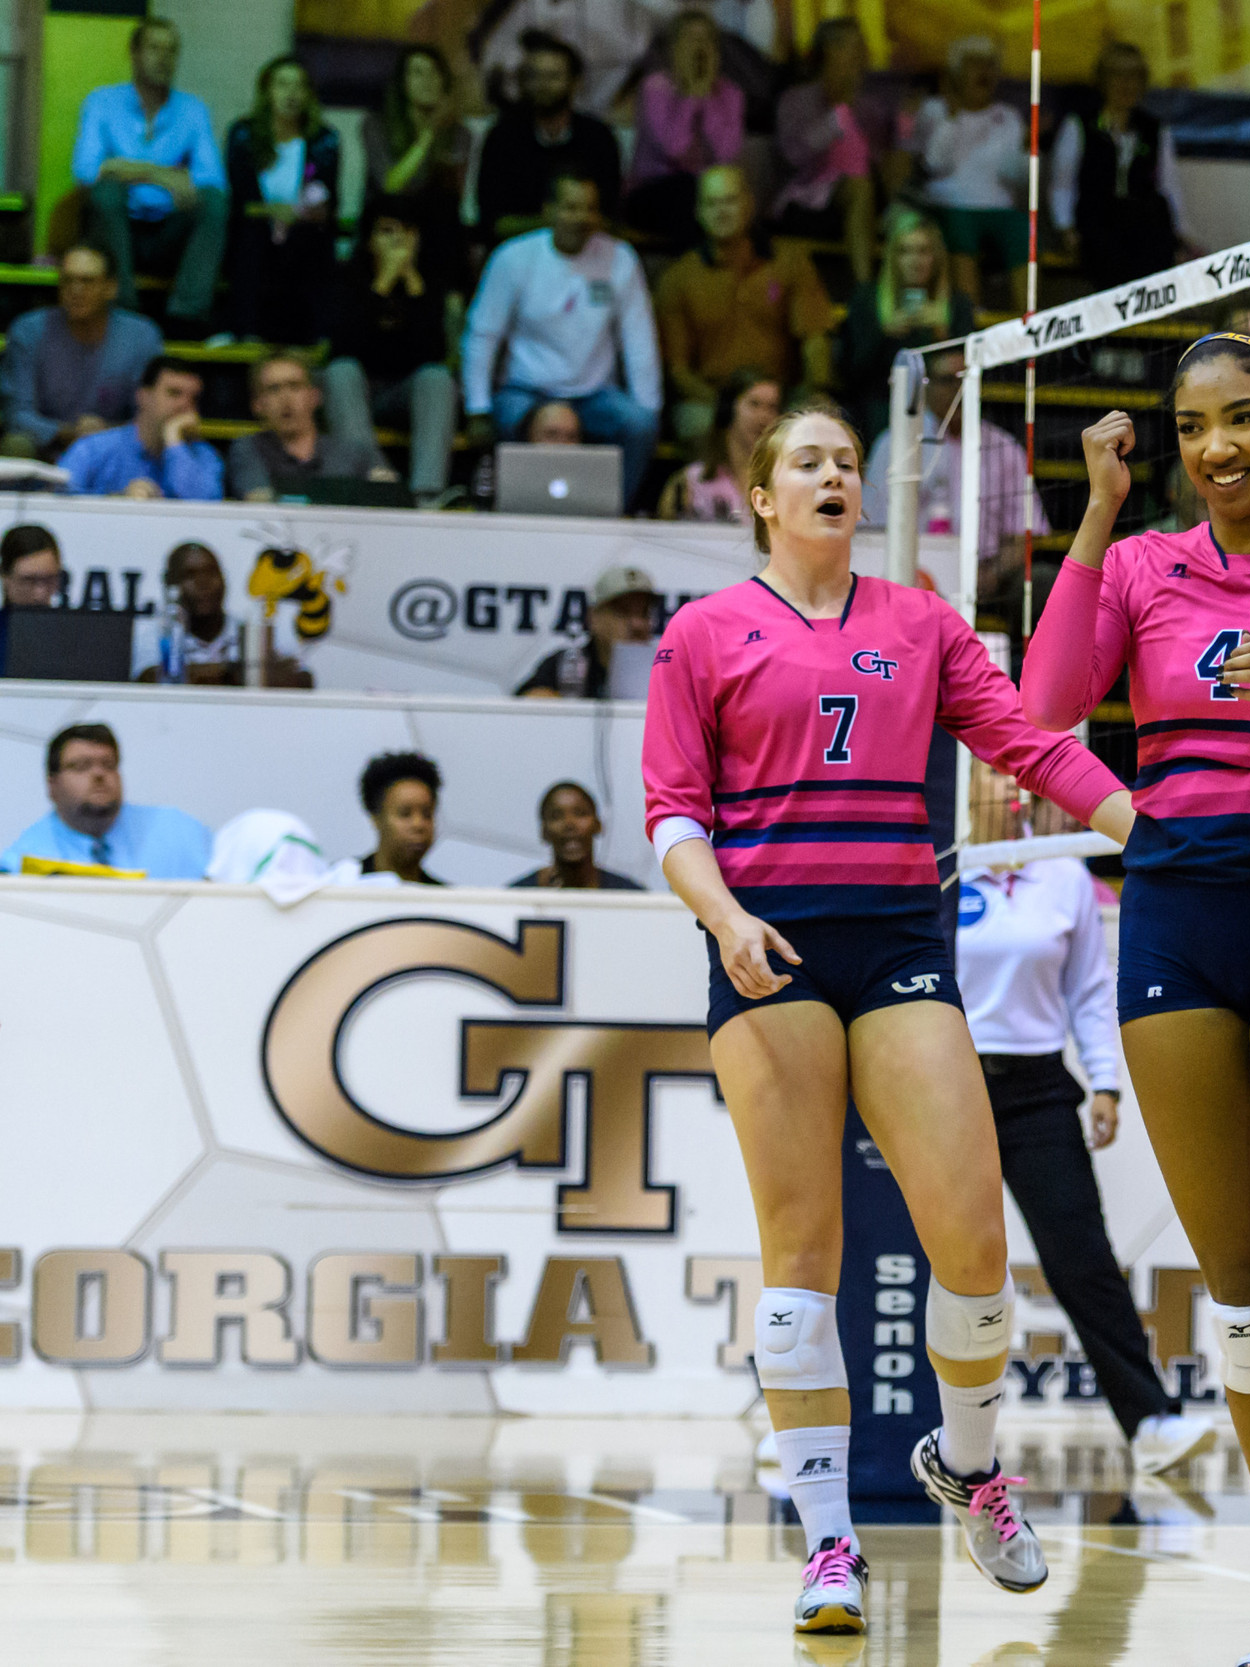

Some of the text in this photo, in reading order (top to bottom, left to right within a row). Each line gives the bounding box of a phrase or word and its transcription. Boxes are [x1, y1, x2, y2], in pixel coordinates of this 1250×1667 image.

[850, 650, 899, 681] GT
[1194, 629, 1246, 702] 4
[819, 695, 859, 764] 7
